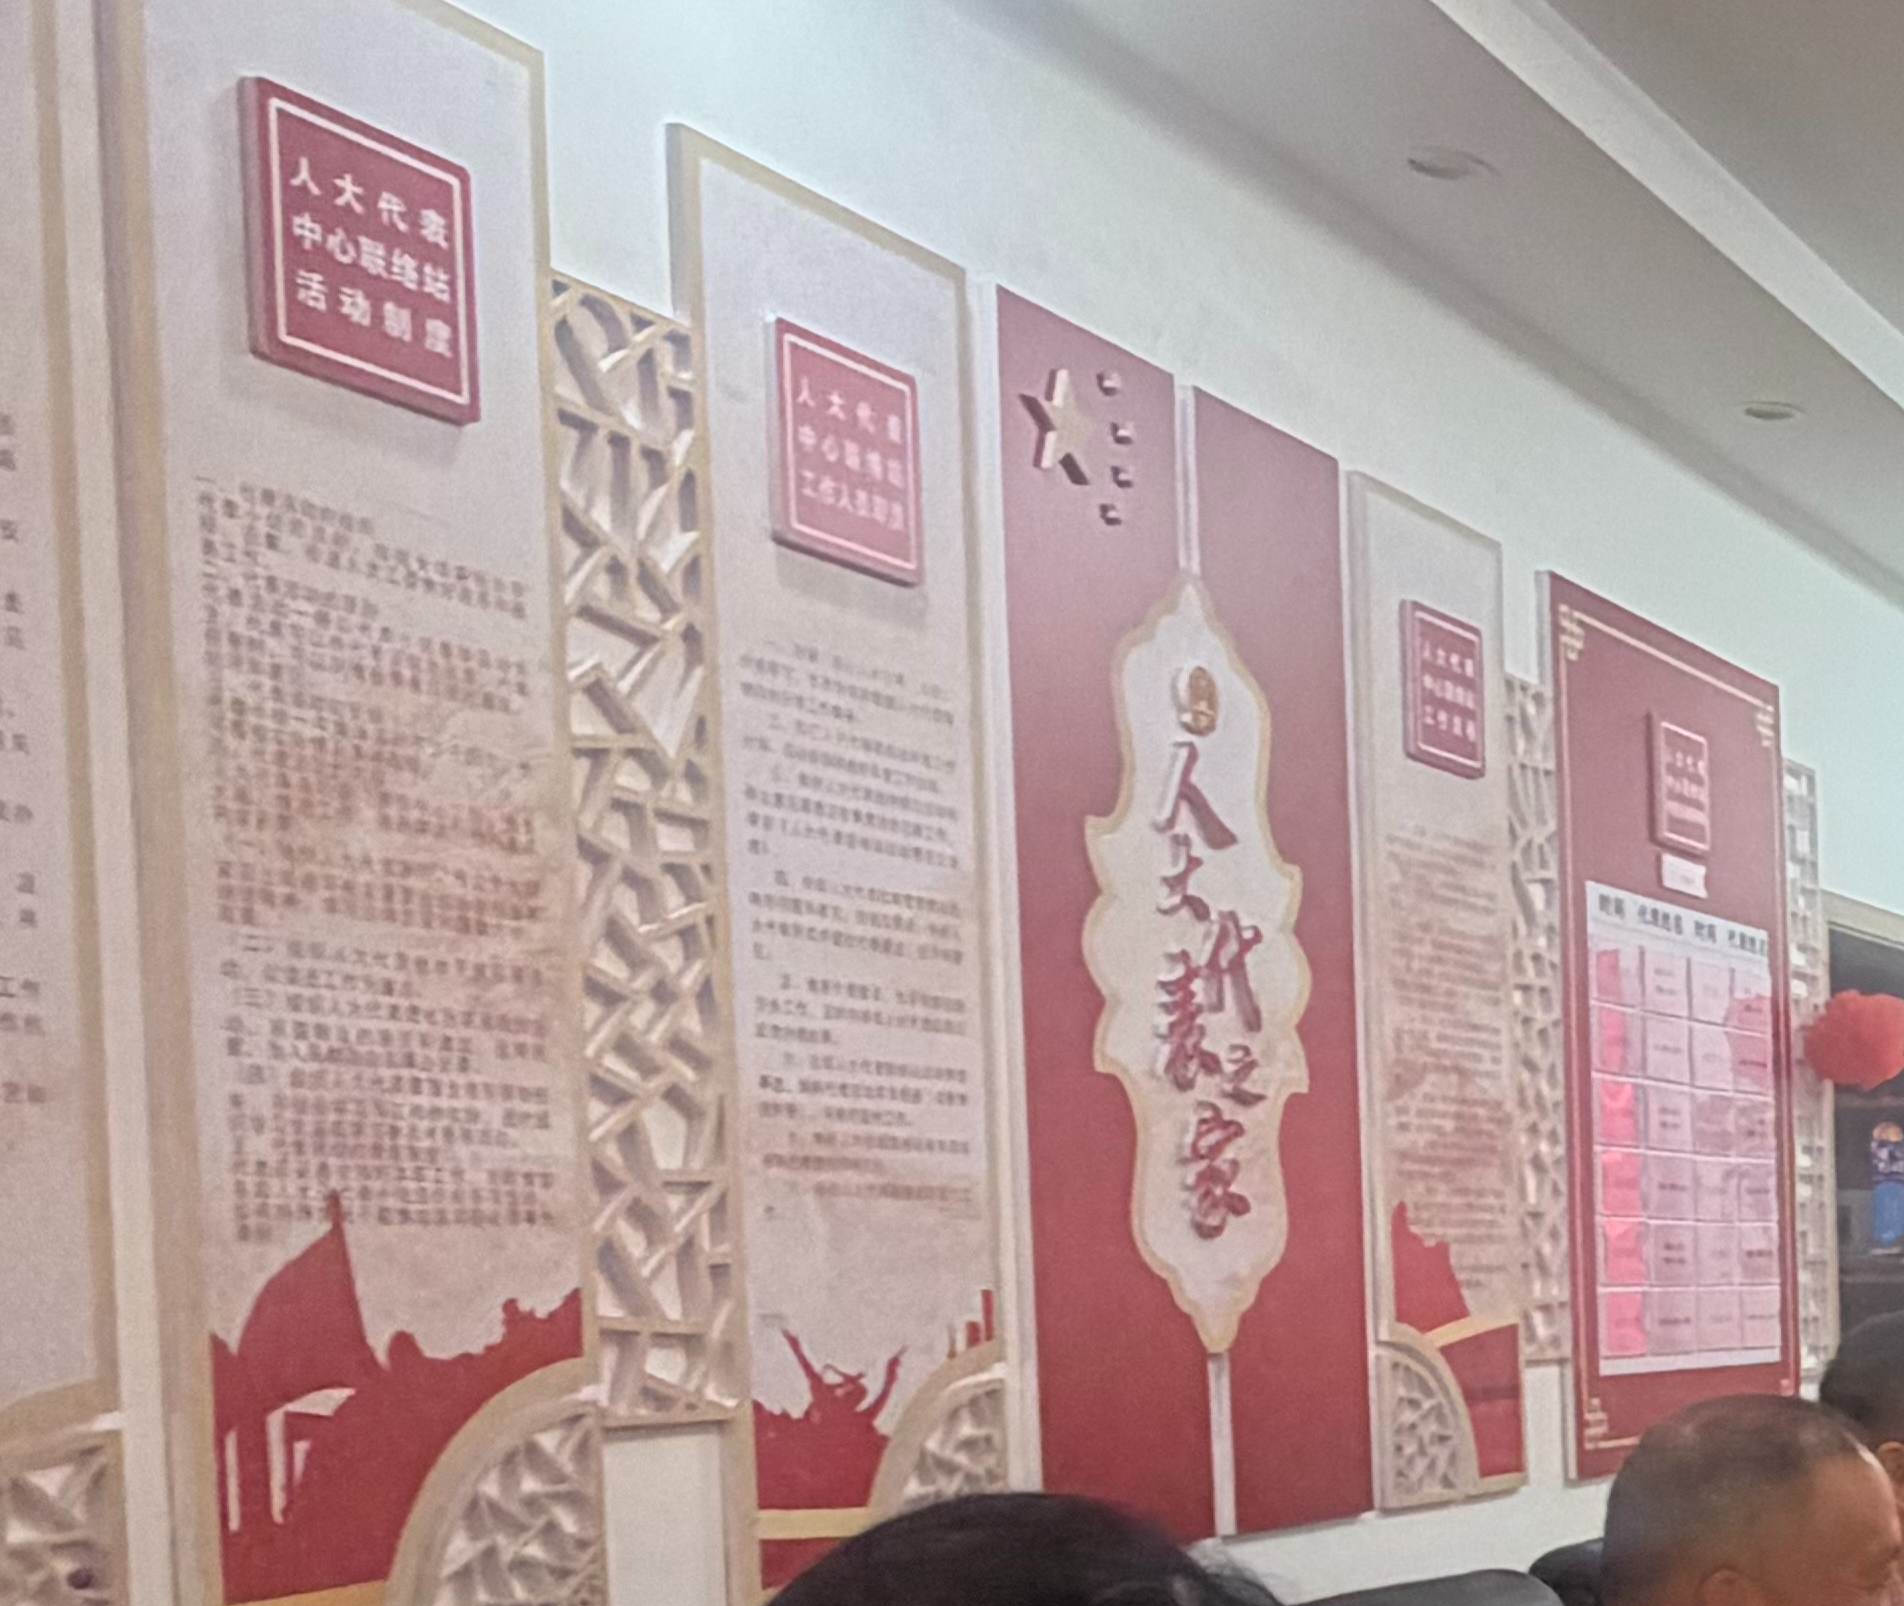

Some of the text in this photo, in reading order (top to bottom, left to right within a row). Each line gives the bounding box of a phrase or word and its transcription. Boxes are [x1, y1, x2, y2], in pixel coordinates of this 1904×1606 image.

[289, 156, 449, 249] 人大代表
[292, 212, 450, 303] 中心联络站
[296, 268, 453, 358] 活动制度
[1153, 738, 1267, 1240] 人大代表之家
